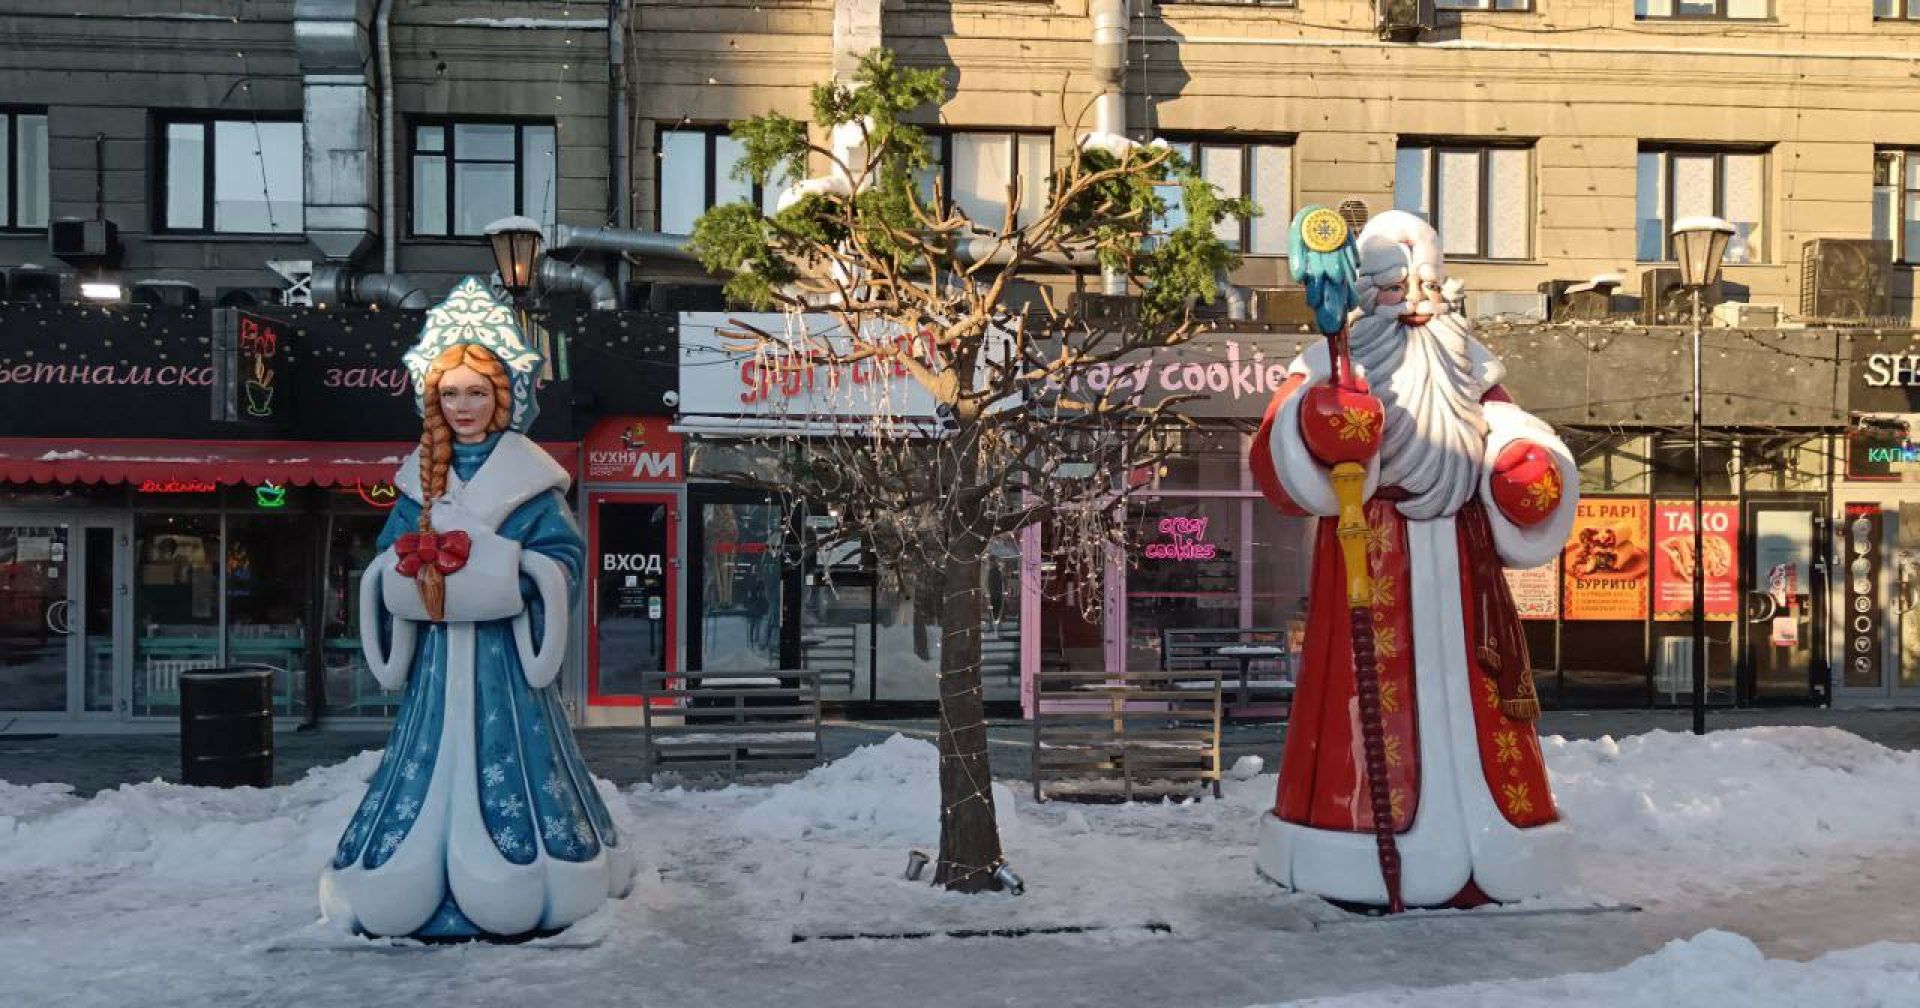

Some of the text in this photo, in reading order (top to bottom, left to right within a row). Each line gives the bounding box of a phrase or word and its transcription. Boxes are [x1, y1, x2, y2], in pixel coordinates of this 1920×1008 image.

[1863, 353, 1920, 387] SH
[590, 450, 637, 463] КУХНЯ
[1576, 504, 1636, 519] EL PAPI
[1145, 534, 1216, 561] cookies
[604, 553, 662, 575] ВХОД
[1575, 578, 1637, 590] БУРРИТО
